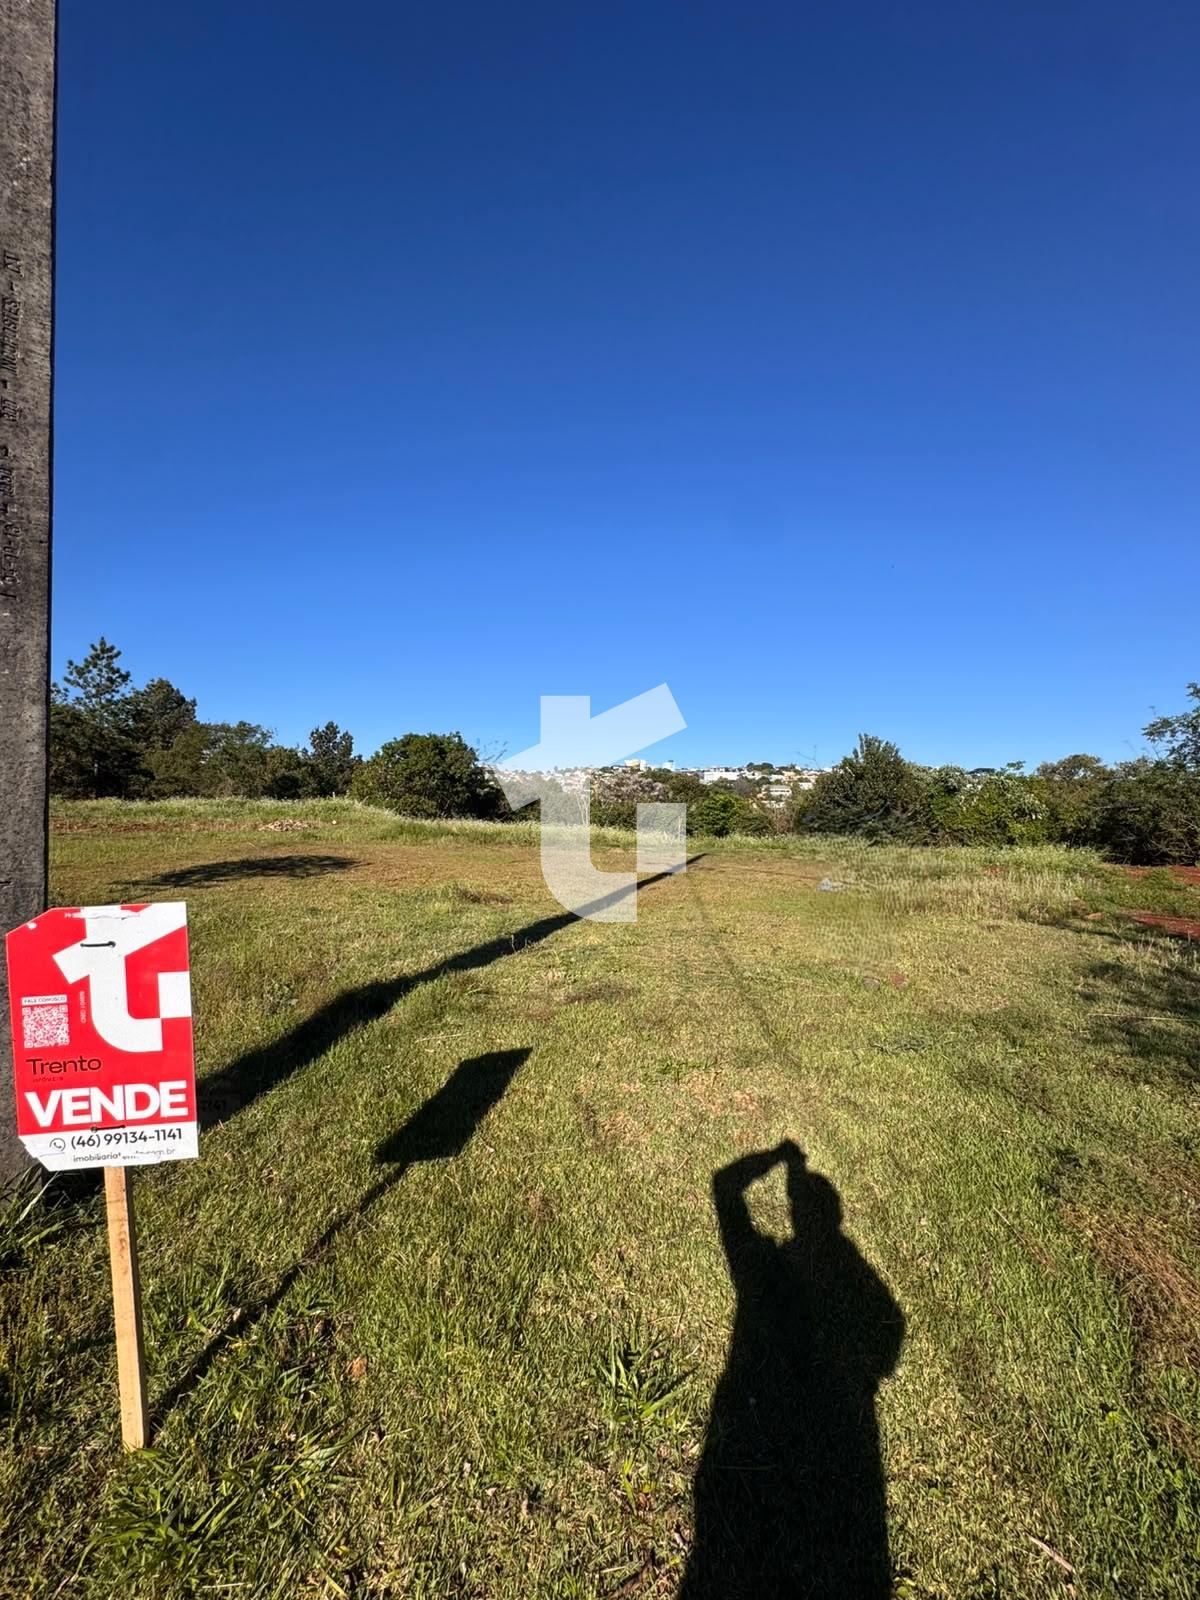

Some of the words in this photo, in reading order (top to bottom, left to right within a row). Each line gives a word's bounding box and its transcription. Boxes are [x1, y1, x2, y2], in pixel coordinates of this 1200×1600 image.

[25, 1055, 102, 1075] Trento
[25, 1080, 189, 1127] VENDE
[71, 1134, 100, 1150] (46)
[104, 1128, 182, 1146] 99134-1141
